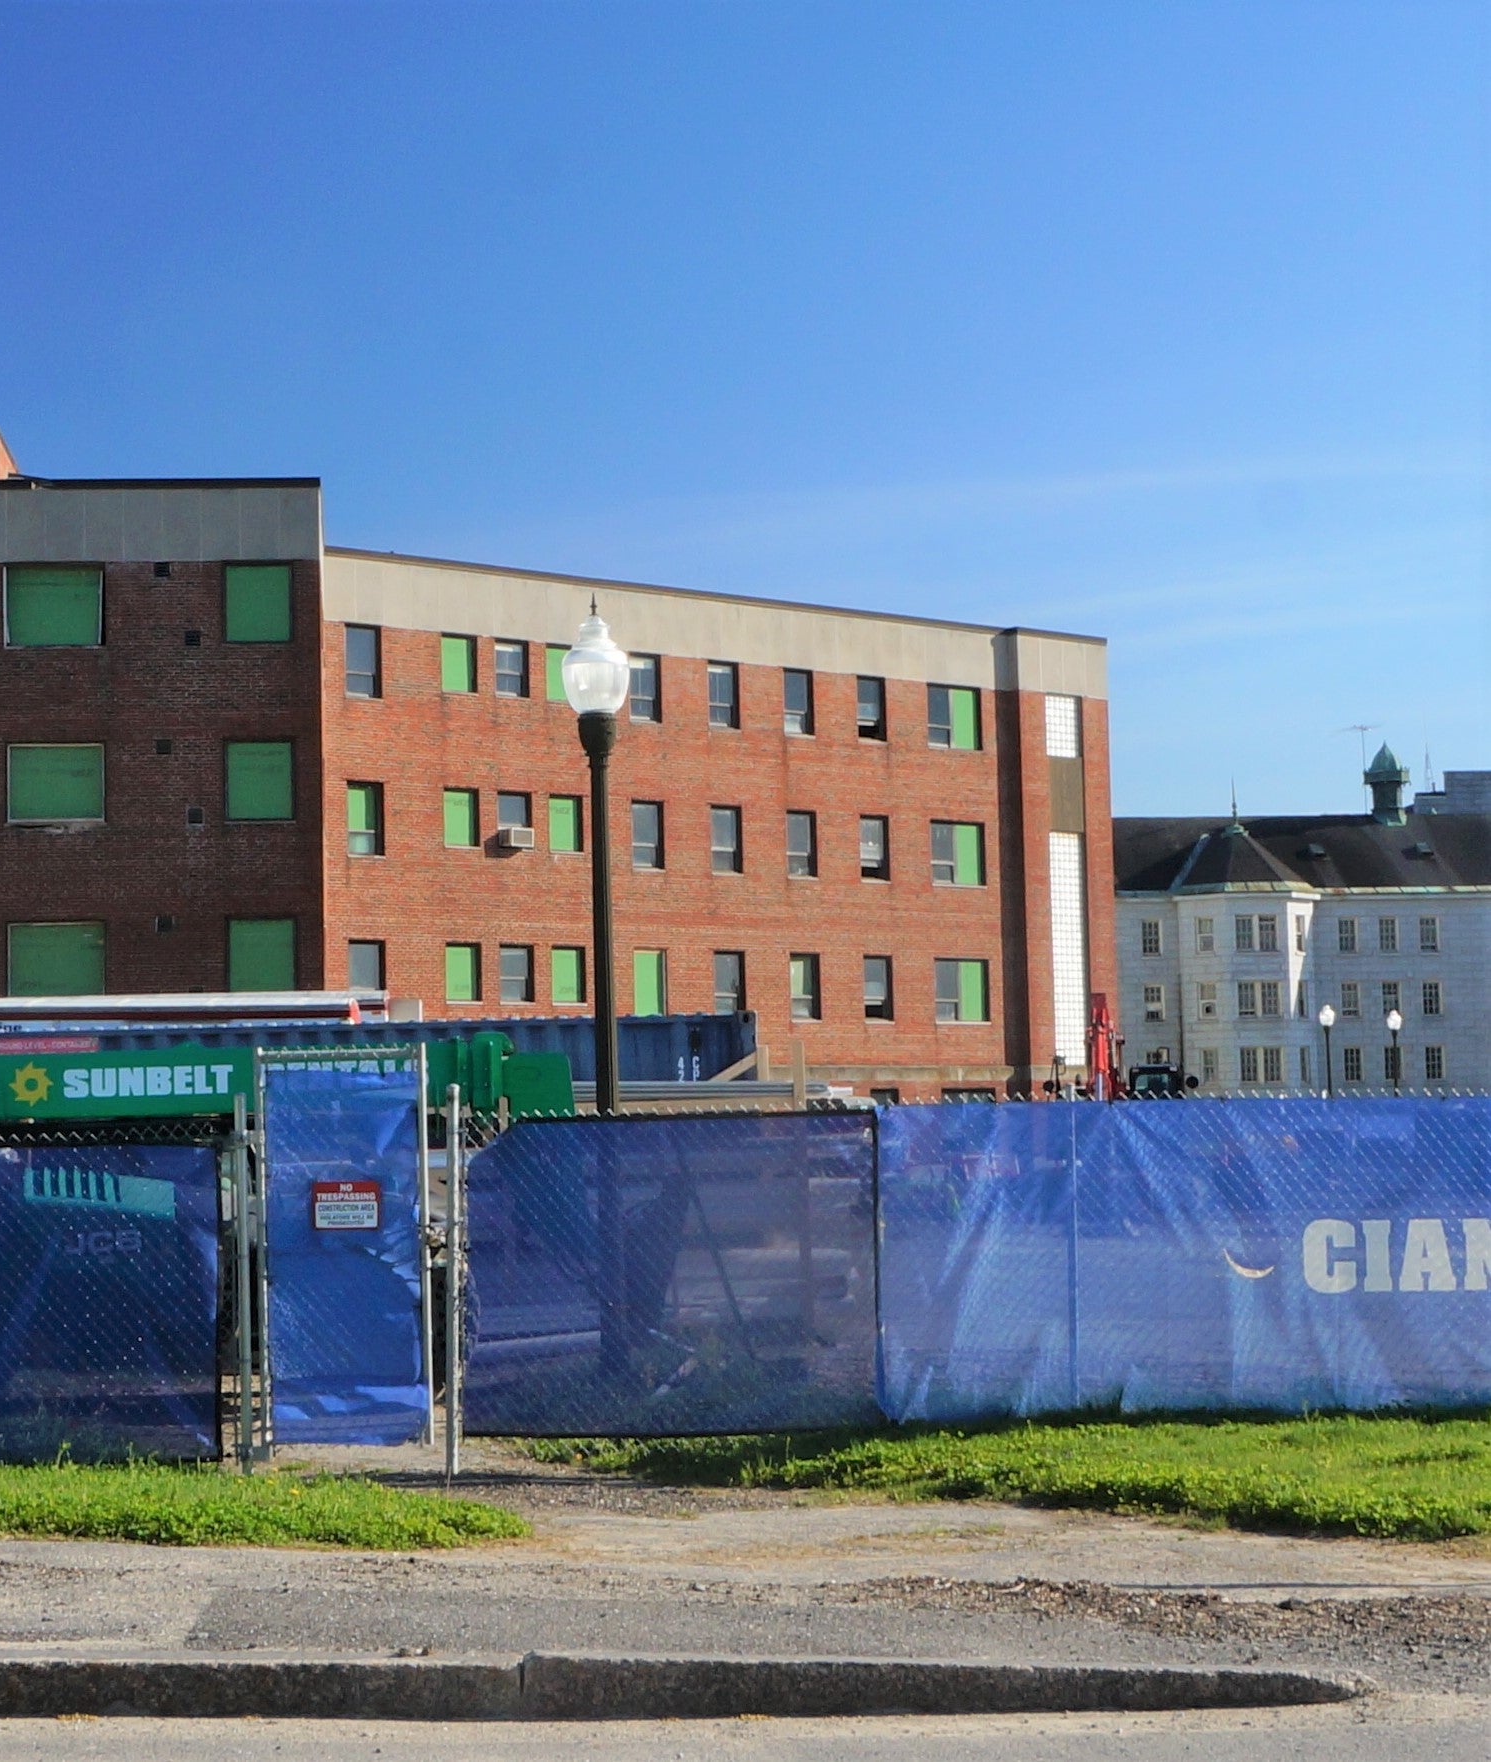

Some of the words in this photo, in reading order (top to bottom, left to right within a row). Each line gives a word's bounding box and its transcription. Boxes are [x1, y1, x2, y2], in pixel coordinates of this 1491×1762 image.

[63, 1064, 234, 1098] SUNBELT
[339, 1183, 353, 1191] NO
[316, 1192, 376, 1201] TRESPASSING
[318, 1204, 359, 1212] CONSTRUCTION
[65, 1230, 142, 1254] JCB
